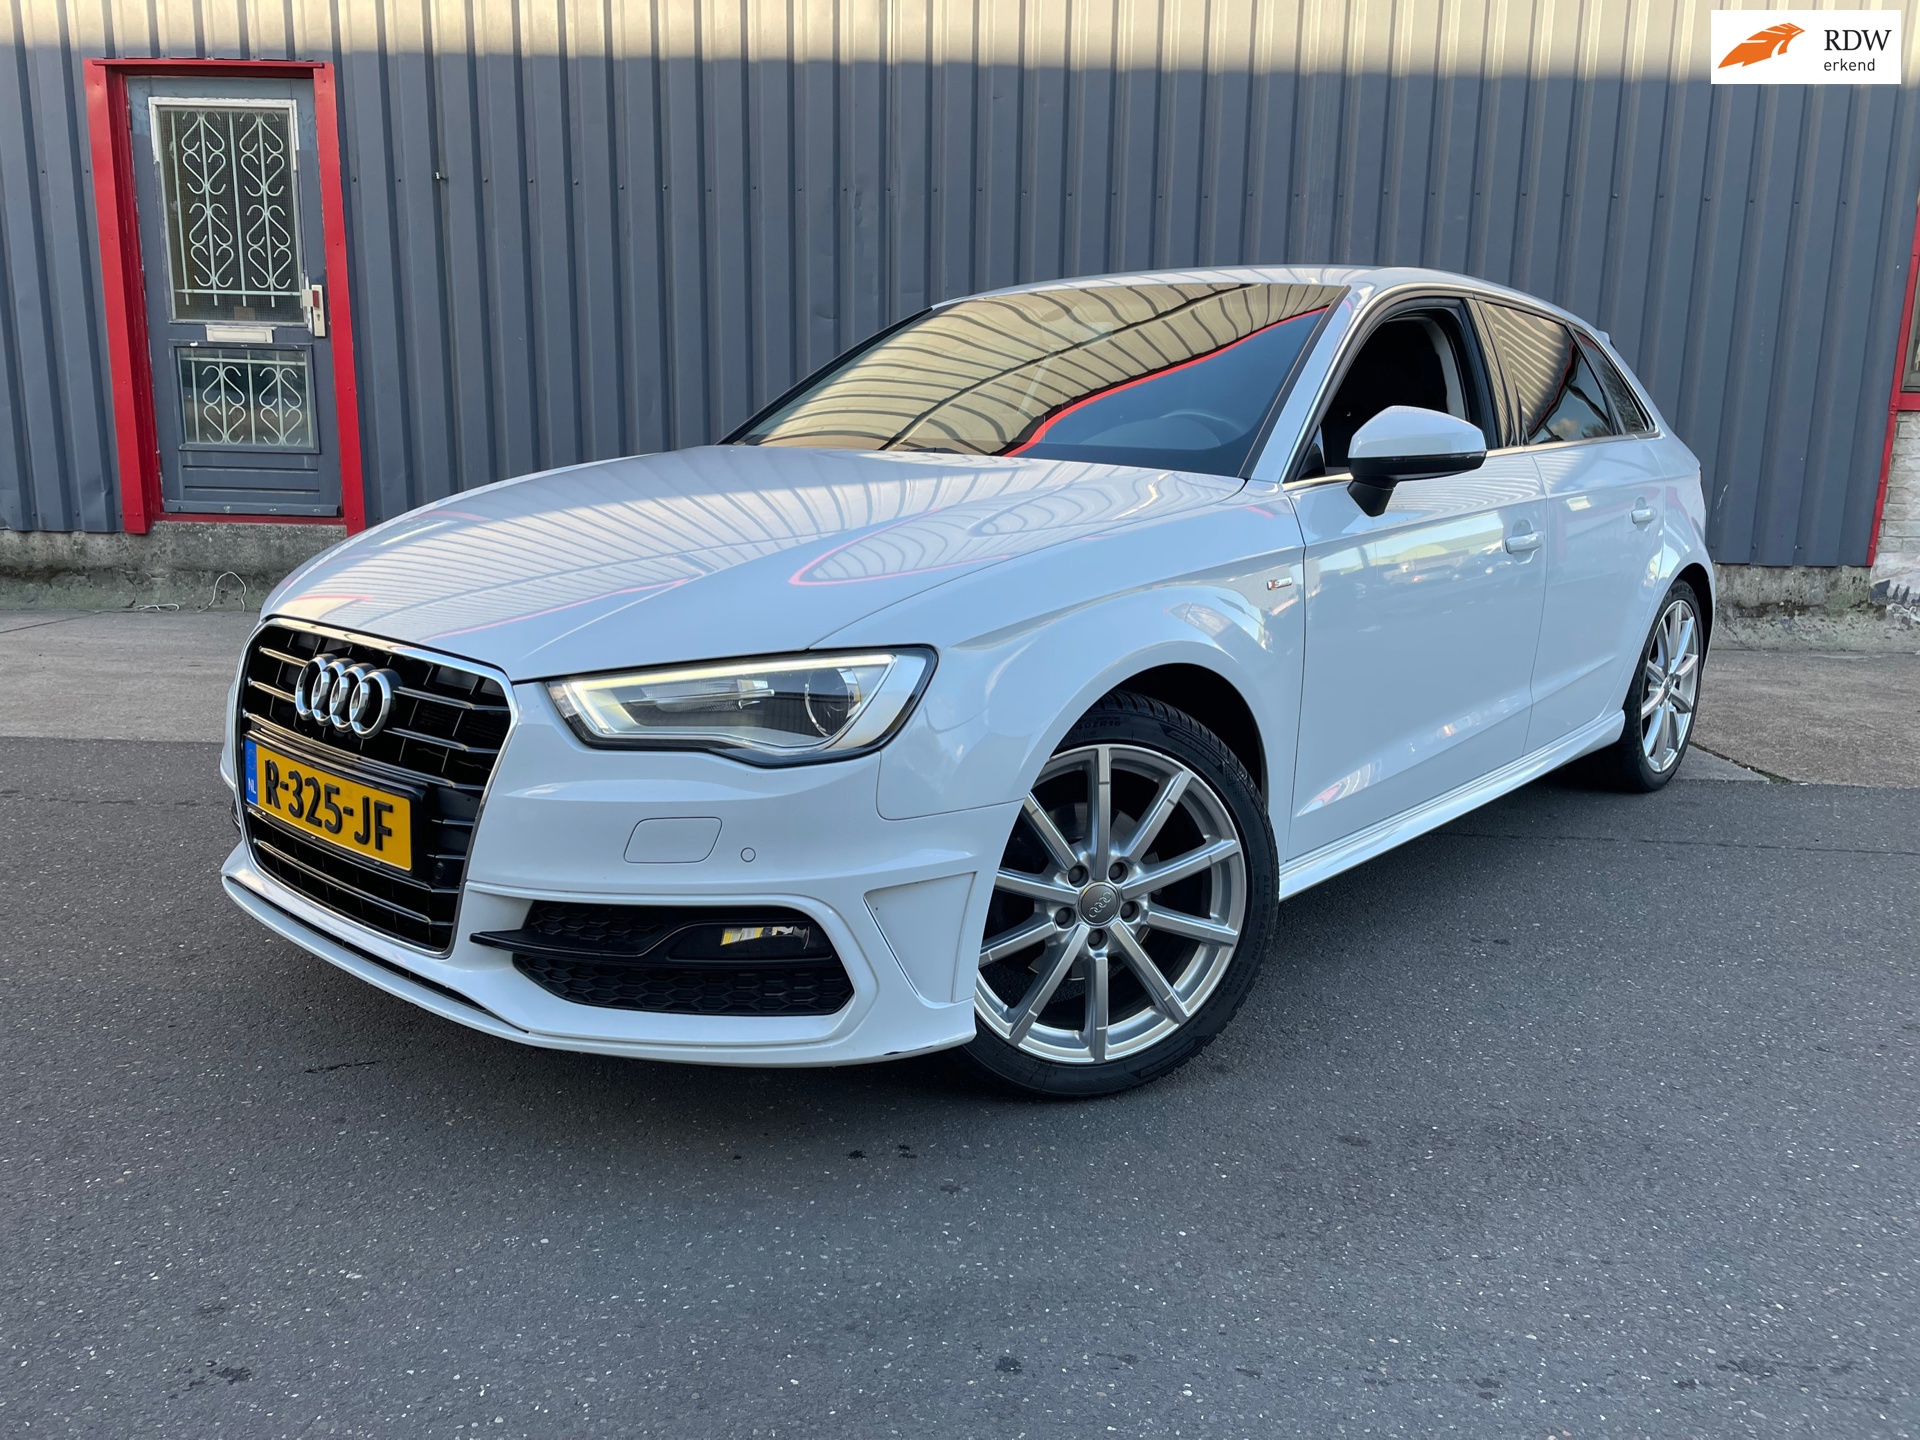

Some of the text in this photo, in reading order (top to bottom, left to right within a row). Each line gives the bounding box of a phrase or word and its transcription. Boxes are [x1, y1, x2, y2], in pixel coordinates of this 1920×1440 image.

[247, 777, 257, 794] NL
[264, 759, 394, 852] R-325-JF
[1262, 874, 1271, 898] ALL
[1250, 903, 1270, 960] SEASON
